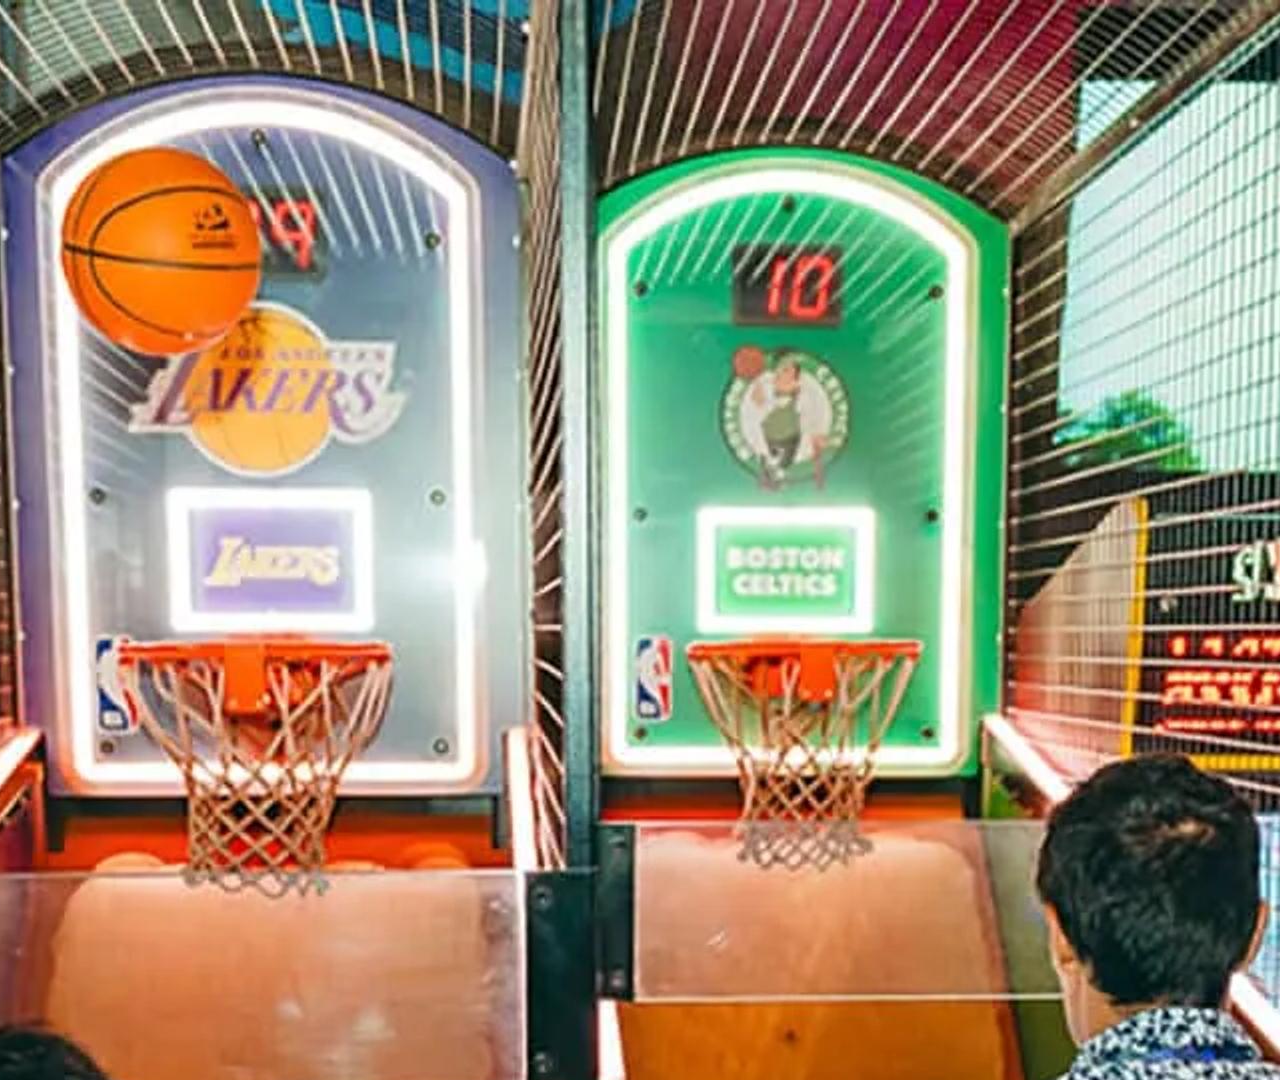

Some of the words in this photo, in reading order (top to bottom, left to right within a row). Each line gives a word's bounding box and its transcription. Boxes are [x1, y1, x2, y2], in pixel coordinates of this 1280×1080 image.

[250, 197, 317, 270] 9
[766, 254, 835, 320] 10
[144, 350, 384, 439] LAKERS
[727, 546, 845, 569] BOSTON
[733, 572, 838, 596] CELTICS
